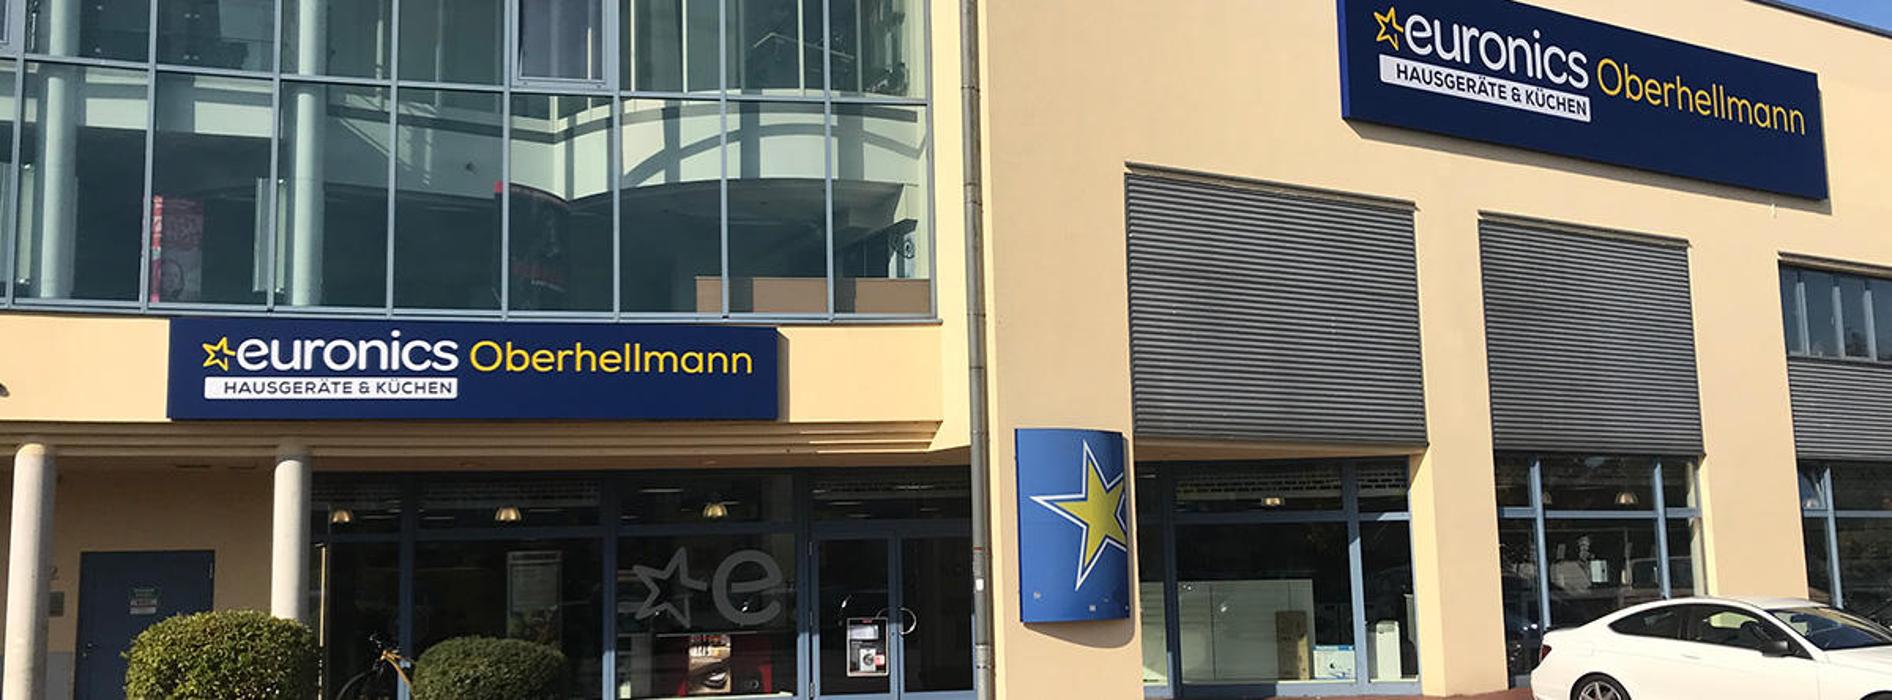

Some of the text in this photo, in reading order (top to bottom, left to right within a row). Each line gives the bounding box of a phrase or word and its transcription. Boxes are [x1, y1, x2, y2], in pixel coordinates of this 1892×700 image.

[1396, 63, 1587, 116] HAUSGERÄTE & KÜCHEN
[1405, 14, 1806, 136] euronics Oberhellmann
[236, 329, 753, 374] euronics Oberhellmann
[224, 378, 453, 395] HAUSGERÄTE & KÜCHEN
